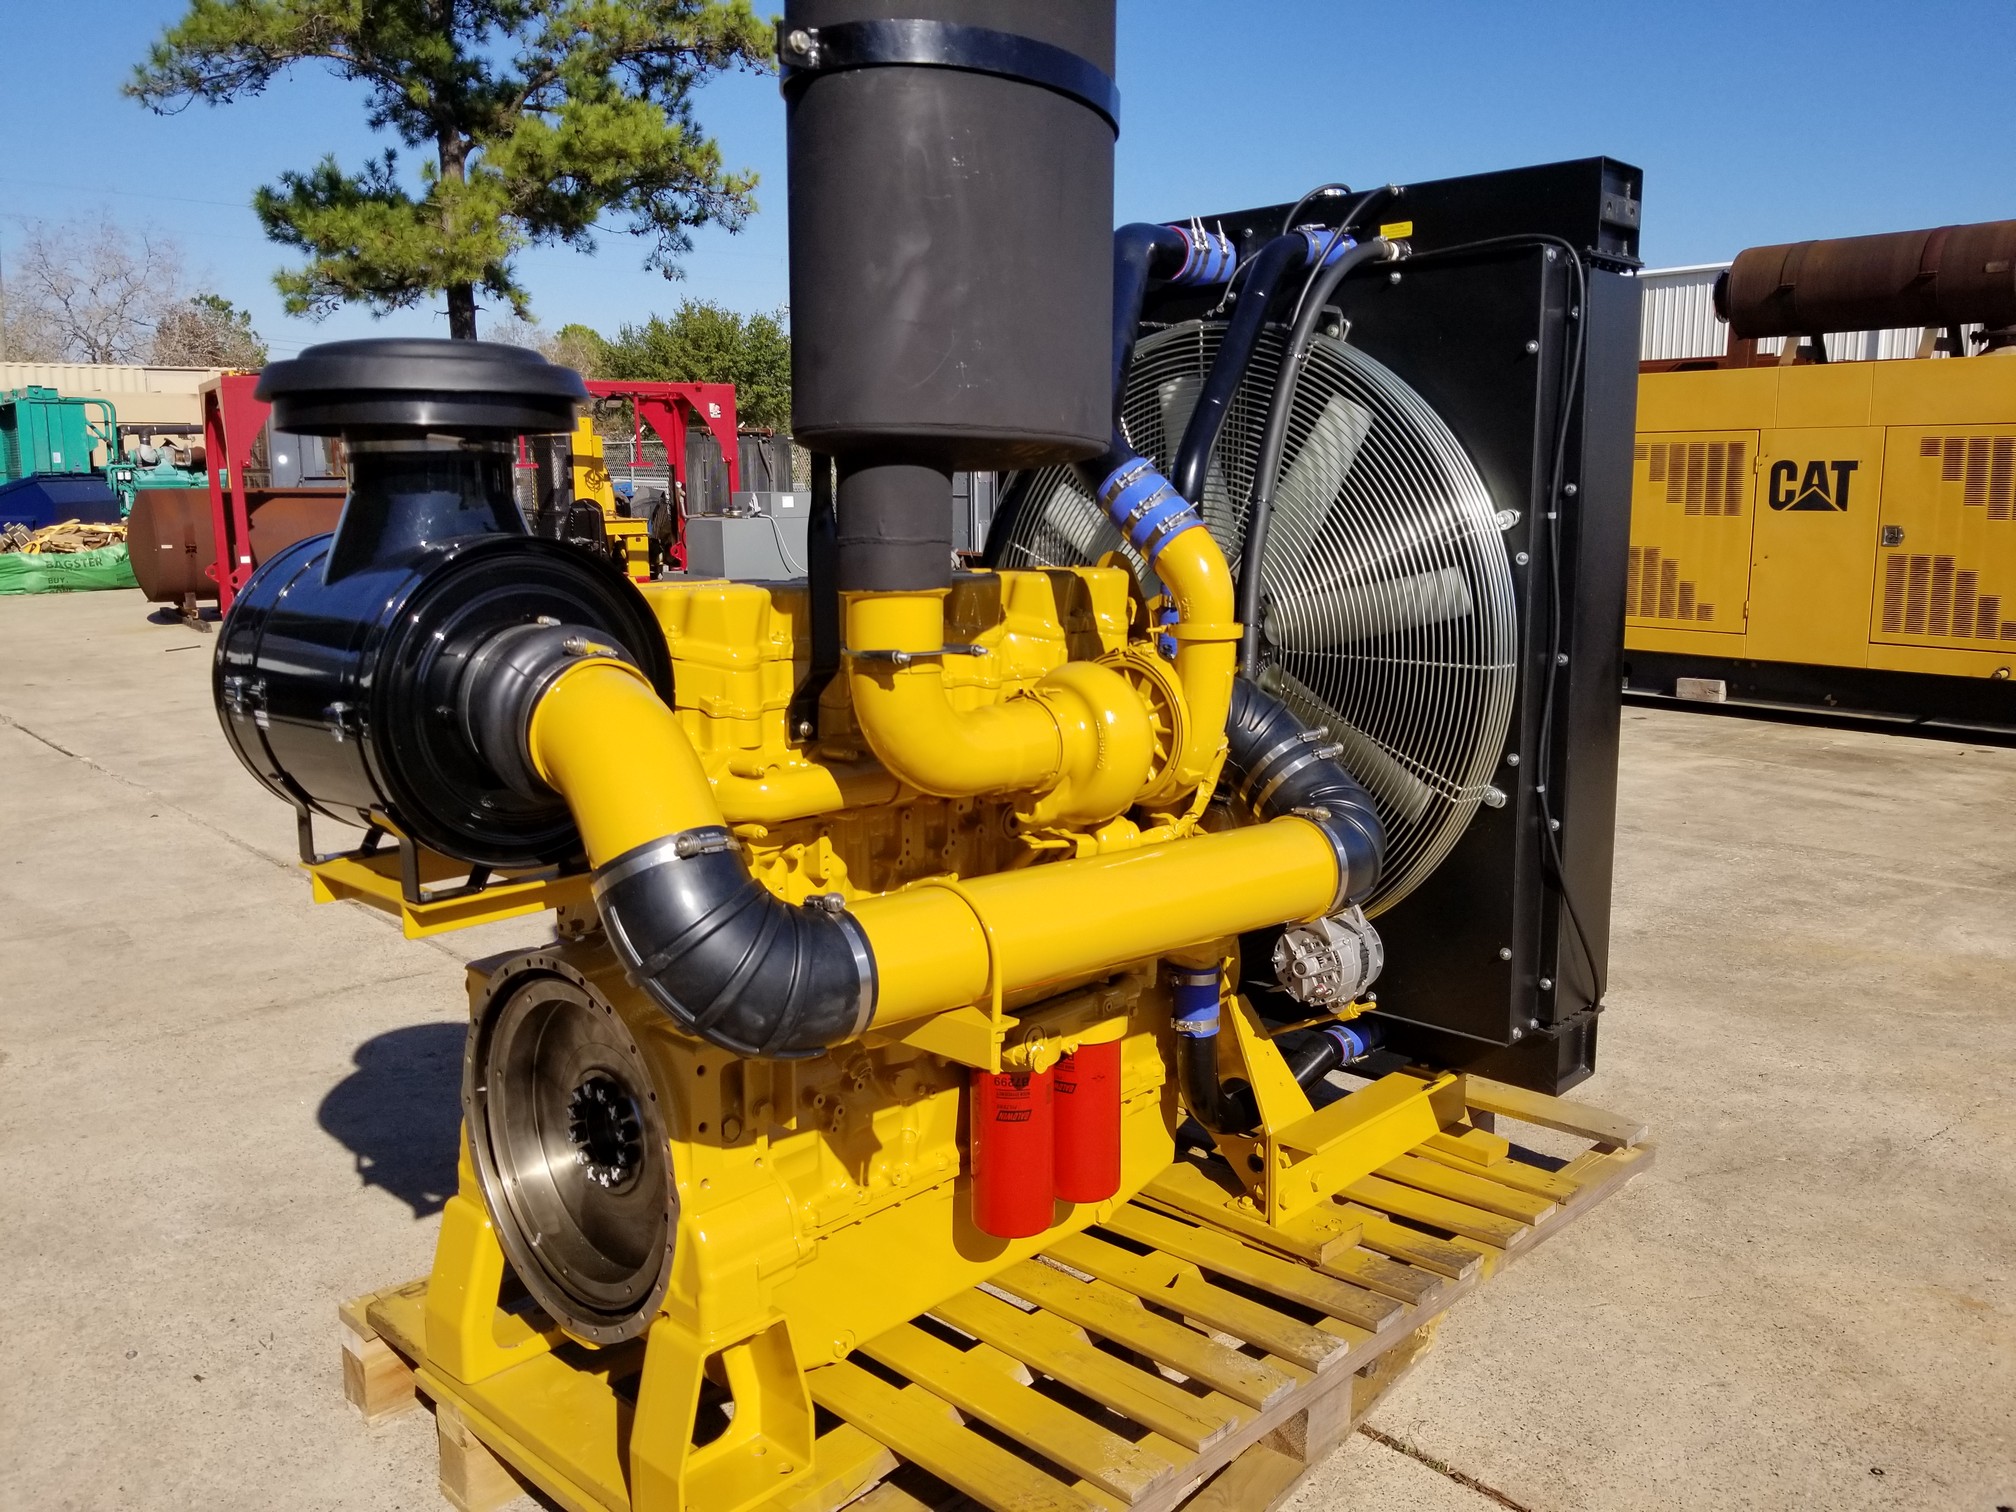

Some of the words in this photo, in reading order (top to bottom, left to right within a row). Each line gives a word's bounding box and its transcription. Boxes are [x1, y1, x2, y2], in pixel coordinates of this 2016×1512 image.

[1769, 460, 1858, 511] CAT
[45, 557, 103, 569] BAGSTER
[997, 1111, 1031, 1121] BALDWIN
